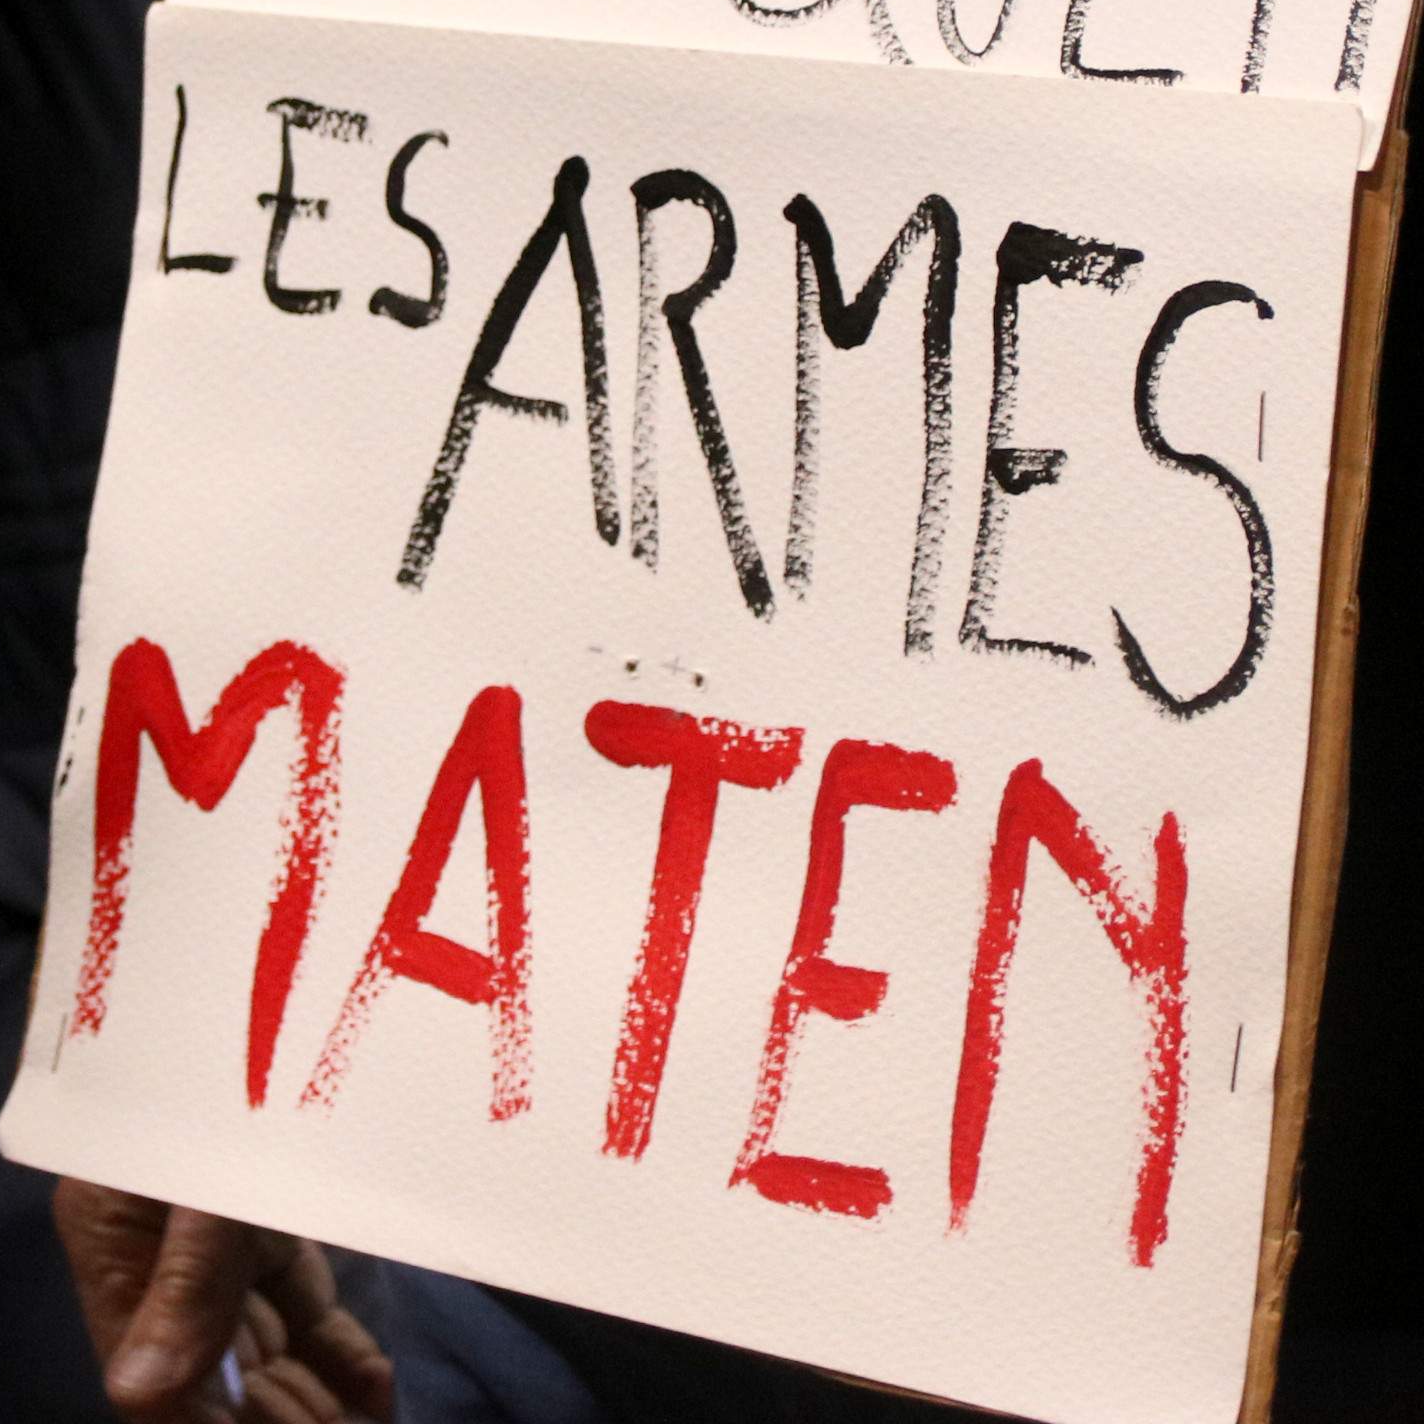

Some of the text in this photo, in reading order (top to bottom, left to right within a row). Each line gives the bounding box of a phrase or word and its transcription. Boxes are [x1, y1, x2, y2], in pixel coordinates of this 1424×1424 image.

[158, 85, 1274, 720] LES ARMES
[70, 637, 1189, 1269] MATEN
